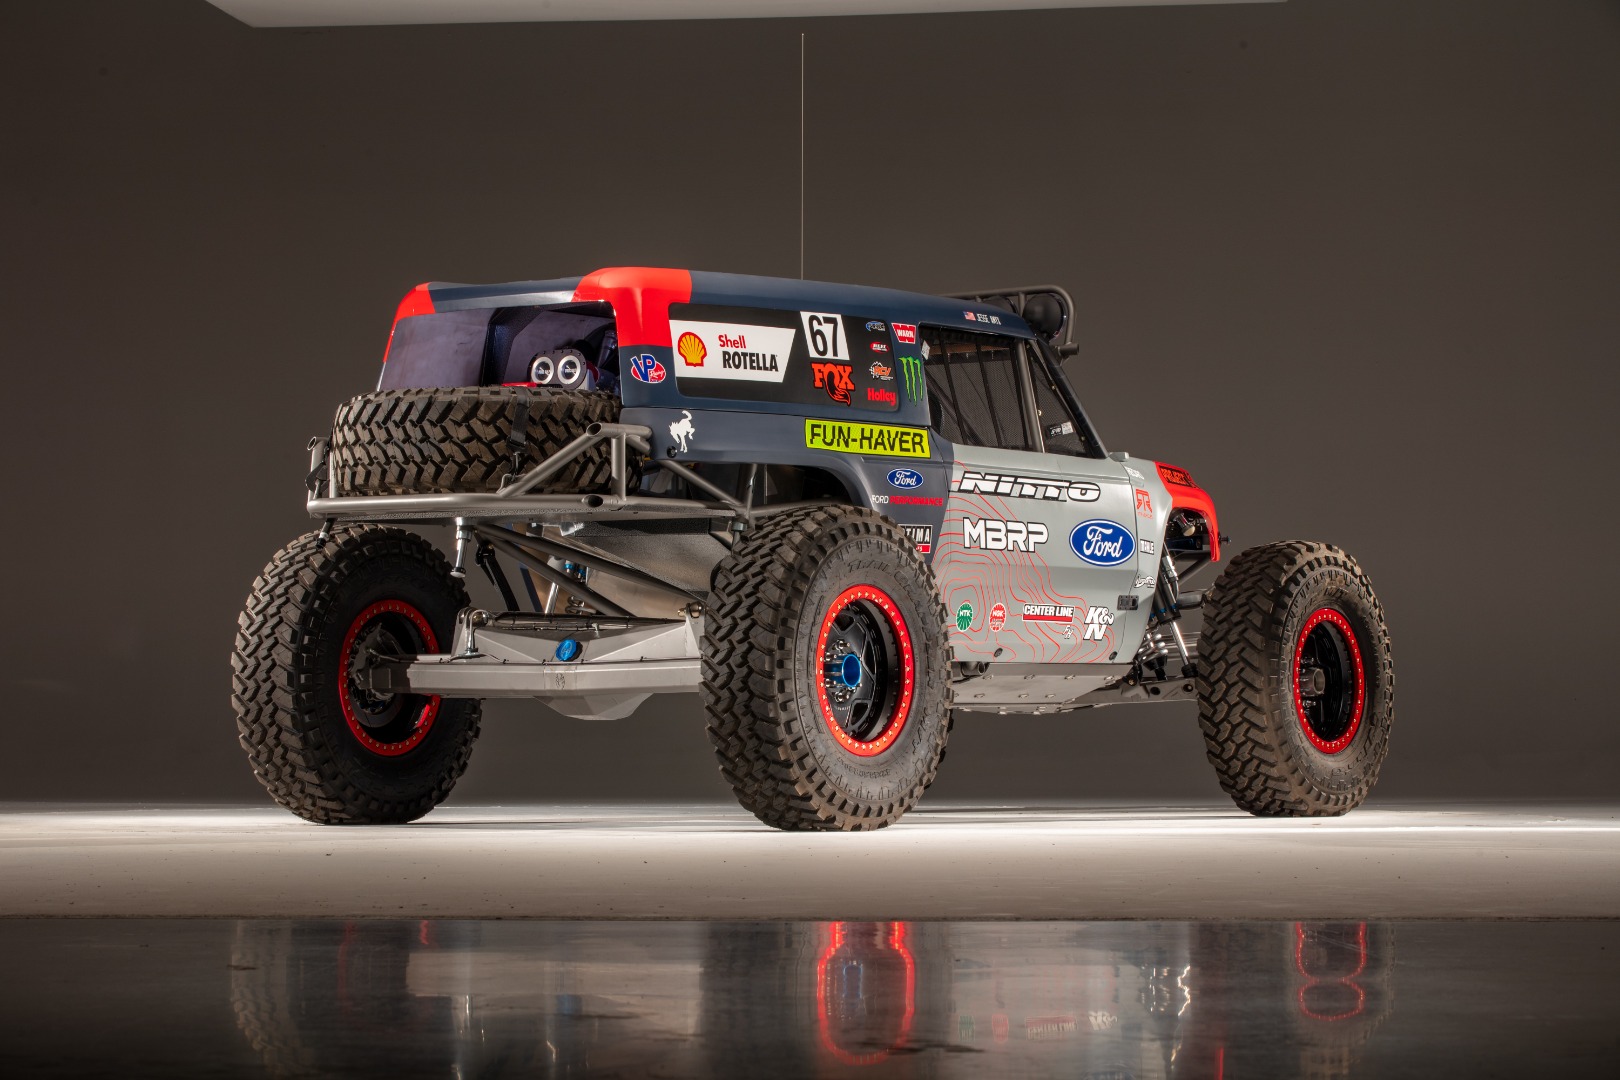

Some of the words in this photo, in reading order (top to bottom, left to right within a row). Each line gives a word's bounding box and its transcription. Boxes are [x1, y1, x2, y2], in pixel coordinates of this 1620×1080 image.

[718, 334, 746, 349] Shell
[808, 315, 839, 357] 67
[897, 329, 914, 338] WARN
[631, 354, 656, 383] VP
[722, 351, 779, 372] ROTELLA
[811, 363, 855, 393] FOX
[867, 388, 896, 406] Holley
[810, 424, 925, 453] FUN-HAVER
[894, 471, 917, 486] Ford
[872, 495, 889, 504] FORD
[889, 496, 944, 506] PERFORMANCE
[963, 517, 1049, 553] MBRP
[1083, 526, 1123, 558] Ford
[1024, 605, 1055, 617] CENTER
[1056, 606, 1074, 618] LINE
